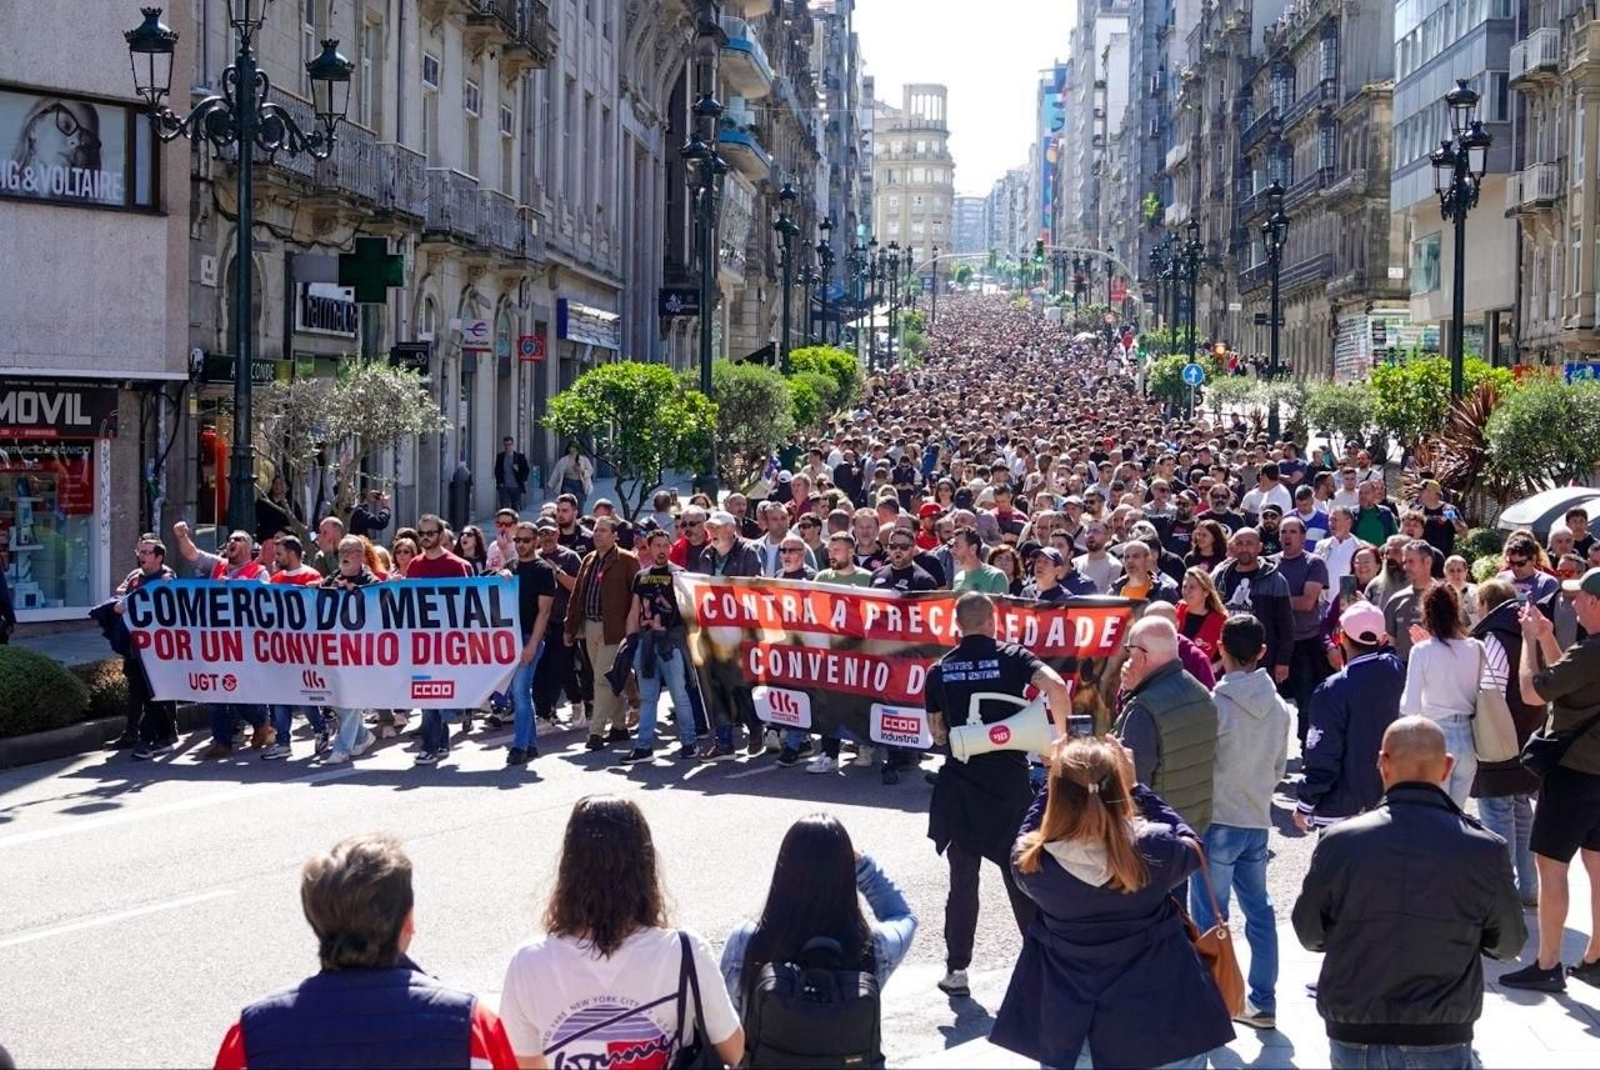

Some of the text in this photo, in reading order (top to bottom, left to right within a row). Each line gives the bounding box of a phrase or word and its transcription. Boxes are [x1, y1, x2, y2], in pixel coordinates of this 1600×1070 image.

[127, 585, 513, 631] COMERCIO DO METAL
[702, 592, 818, 625] CONTRA
[830, 599, 847, 629] A
[132, 629, 516, 666] POR UN CONVENIO DIGNO
[188, 673, 219, 691] UGT
[750, 647, 889, 692] CONVENIO
[413, 683, 453, 697] CCOO
[883, 716, 919, 731] CCOO
[570, 999, 590, 1011] NEW
[593, 995, 618, 1004] YORK
[620, 997, 640, 1008] CITY
